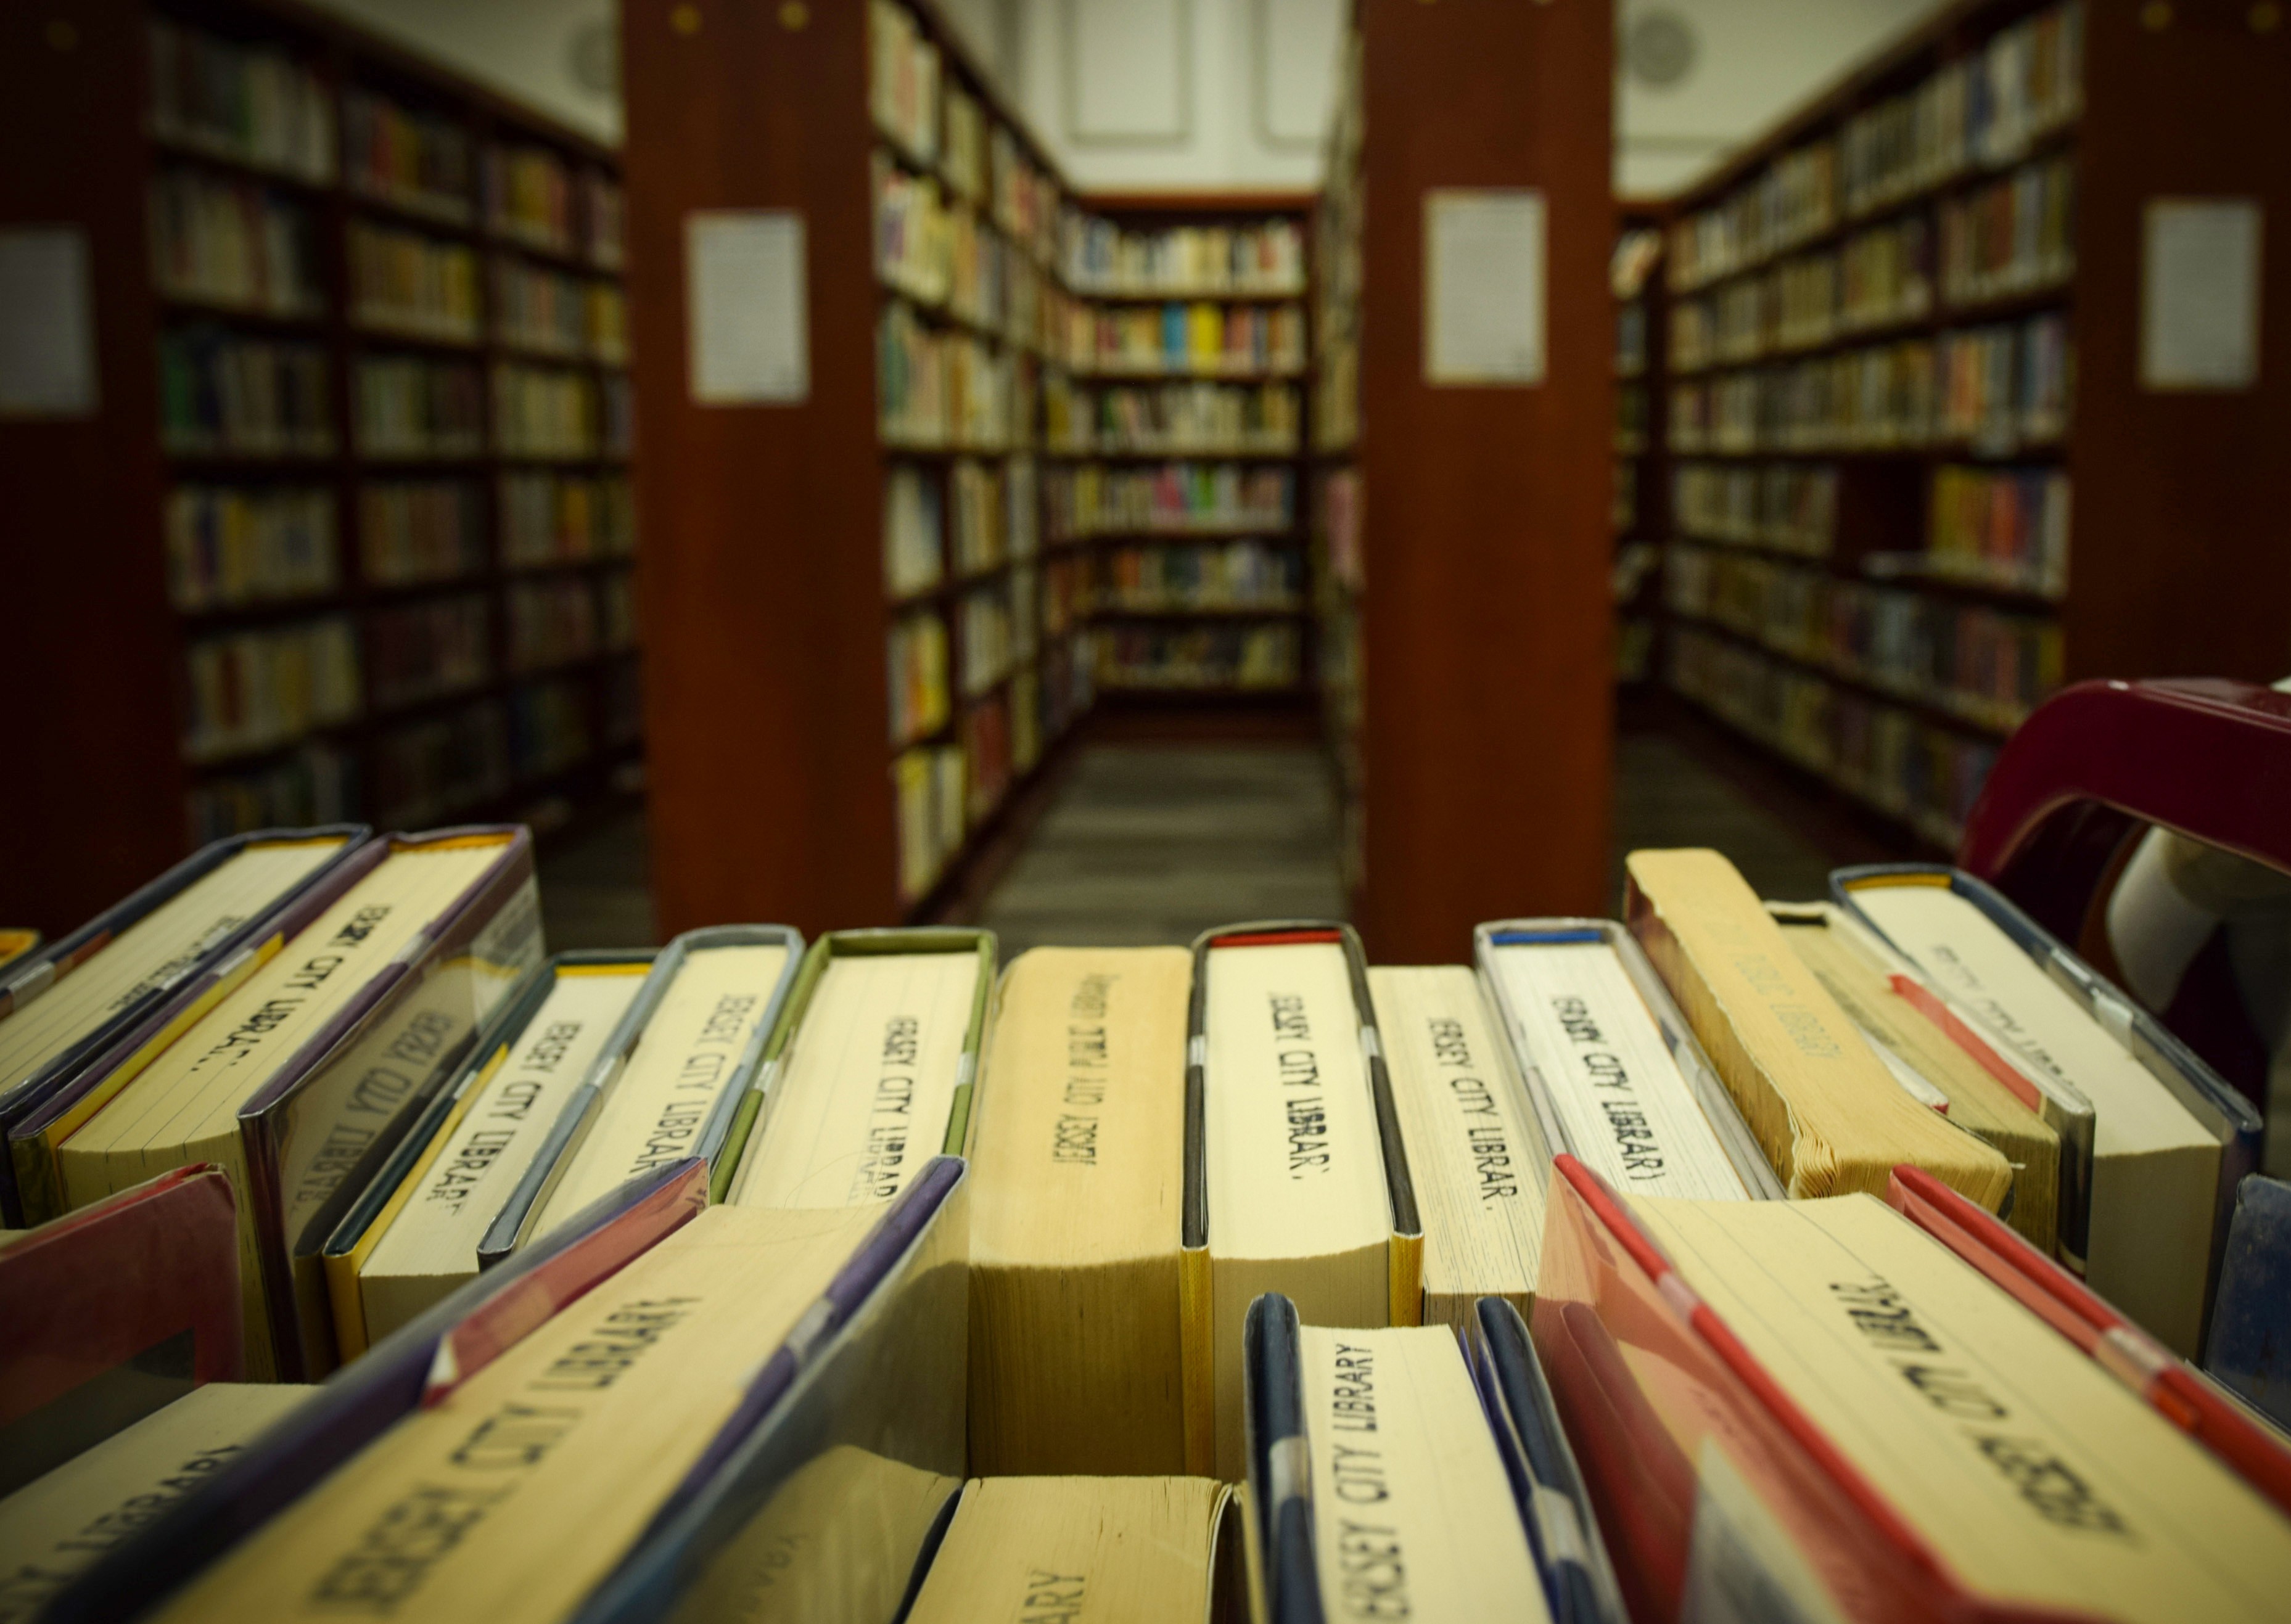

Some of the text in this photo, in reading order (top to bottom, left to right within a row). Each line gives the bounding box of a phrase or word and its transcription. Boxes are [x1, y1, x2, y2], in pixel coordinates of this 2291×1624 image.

[284, 956, 343, 989] CITY
[191, 996, 305, 1072] LIBRA
[519, 1021, 583, 1073] ERSEY
[882, 1015, 918, 1067] ERSEY
[1549, 995, 1607, 1044] ERSEY
[1582, 1052, 1634, 1092] CITY
[677, 1052, 726, 1090] CITY
[873, 1077, 913, 1115] CITY
[1063, 1077, 1108, 1105] CITY
[1269, 993, 1330, 1179] ERSEY CITY LIBRAR
[1450, 1077, 1499, 1117] CITY
[488, 1080, 542, 1120] CITY
[628, 1101, 708, 1173] LIBRAR
[1052, 1113, 1098, 1166] JERSEY
[1468, 1127, 1518, 1210] LIBRAR
[1331, 1343, 1378, 1433] LIBRARY
[1885, 1356, 2009, 1419] CITY
[448, 1401, 587, 1472] CITY
[1332, 1444, 1390, 1505] CITY
